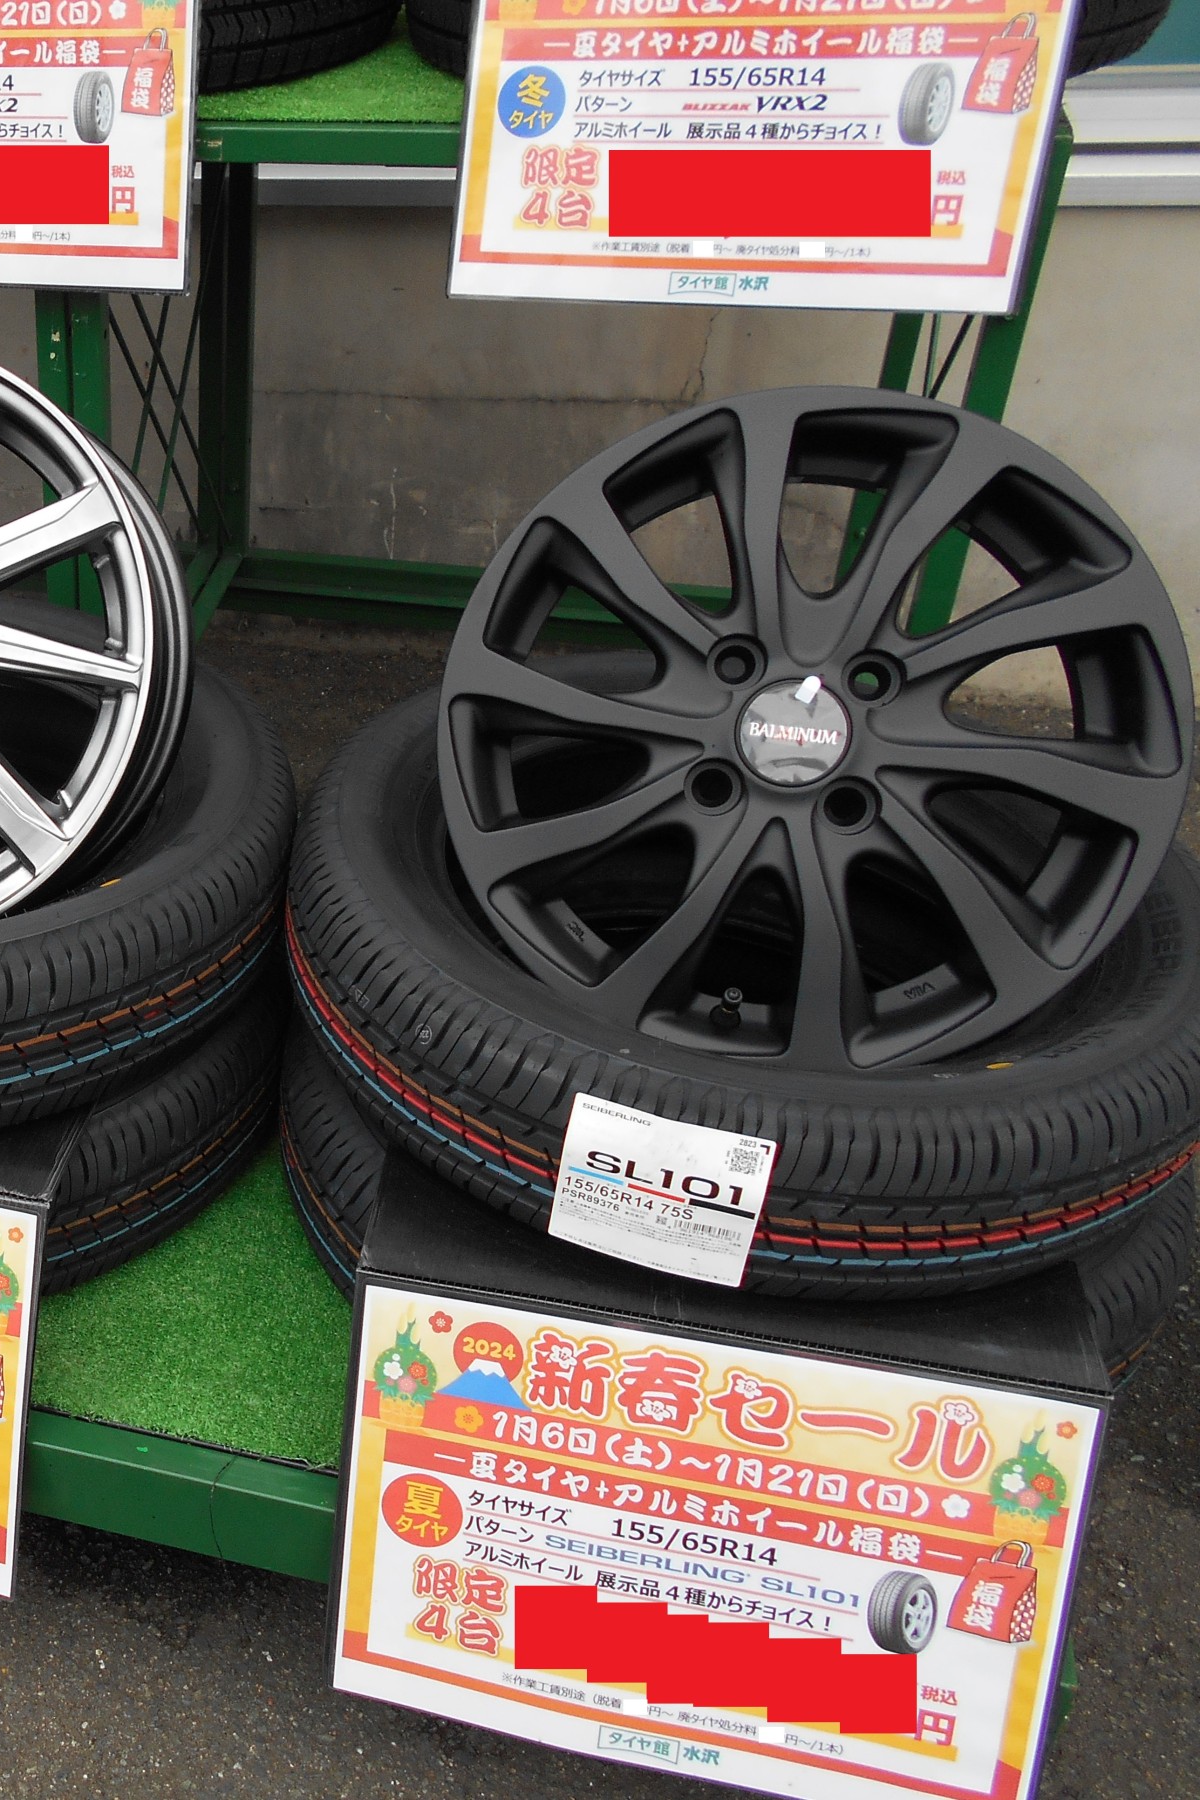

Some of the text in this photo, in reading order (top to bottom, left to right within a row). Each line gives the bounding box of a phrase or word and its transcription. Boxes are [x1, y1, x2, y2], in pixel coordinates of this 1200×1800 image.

[516, 74, 550, 106] 冬
[579, 67, 826, 89] タイヤサイズ 155/65R14
[510, 109, 552, 128] タイヤ
[575, 95, 632, 112] パターン
[756, 95, 828, 112] VRX2
[574, 122, 671, 139] アルミホイール
[523, 147, 598, 185] 限定
[112, 187, 135, 213] 円
[522, 191, 592, 227] 4台
[932, 196, 962, 225] 円
[678, 276, 768, 290] タイヤ館 水沢
[750, 722, 838, 744] BALMINUM
[582, 1103, 651, 1126] SEIBERLING
[586, 1151, 742, 1205] SL101
[564, 1176, 693, 1219] 155/65R14 75S
[462, 1336, 516, 1361] 2024
[526, 1331, 986, 1481] 新春セール
[404, 1481, 441, 1514] 夏
[396, 1515, 449, 1541] タイヤ
[469, 1491, 778, 1567] タイヤサイズ 155/65R14
[465, 1540, 582, 1582] アルミホイール
[465, 1515, 859, 1609] パターン SEIBERLING SL101
[414, 1558, 508, 1612] 限定
[417, 1606, 501, 1656] 4台
[916, 1712, 956, 1746] 円
[608, 1731, 719, 1766] タイヤ館 水沢
